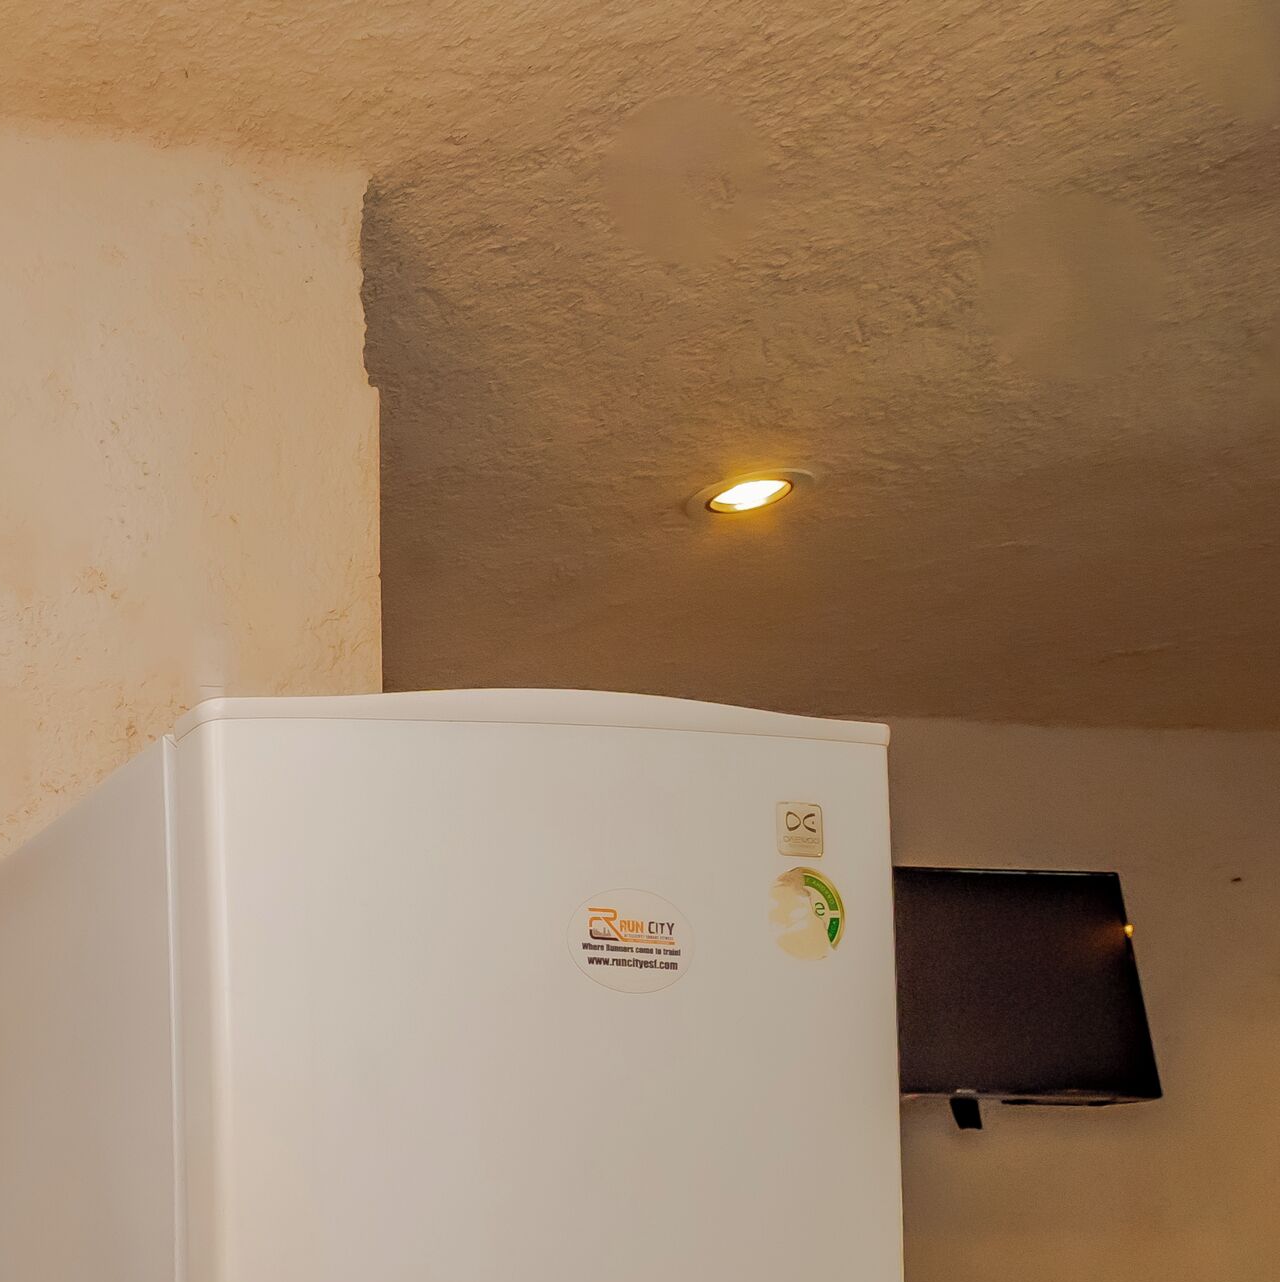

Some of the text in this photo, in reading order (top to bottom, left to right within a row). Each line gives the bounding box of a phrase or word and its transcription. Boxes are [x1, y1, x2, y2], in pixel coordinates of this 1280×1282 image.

[619, 920, 644, 933] RUN
[582, 942, 605, 952] Where
[606, 943, 635, 953] Runners
[635, 946, 654, 955] come
[655, 946, 662, 956] to
